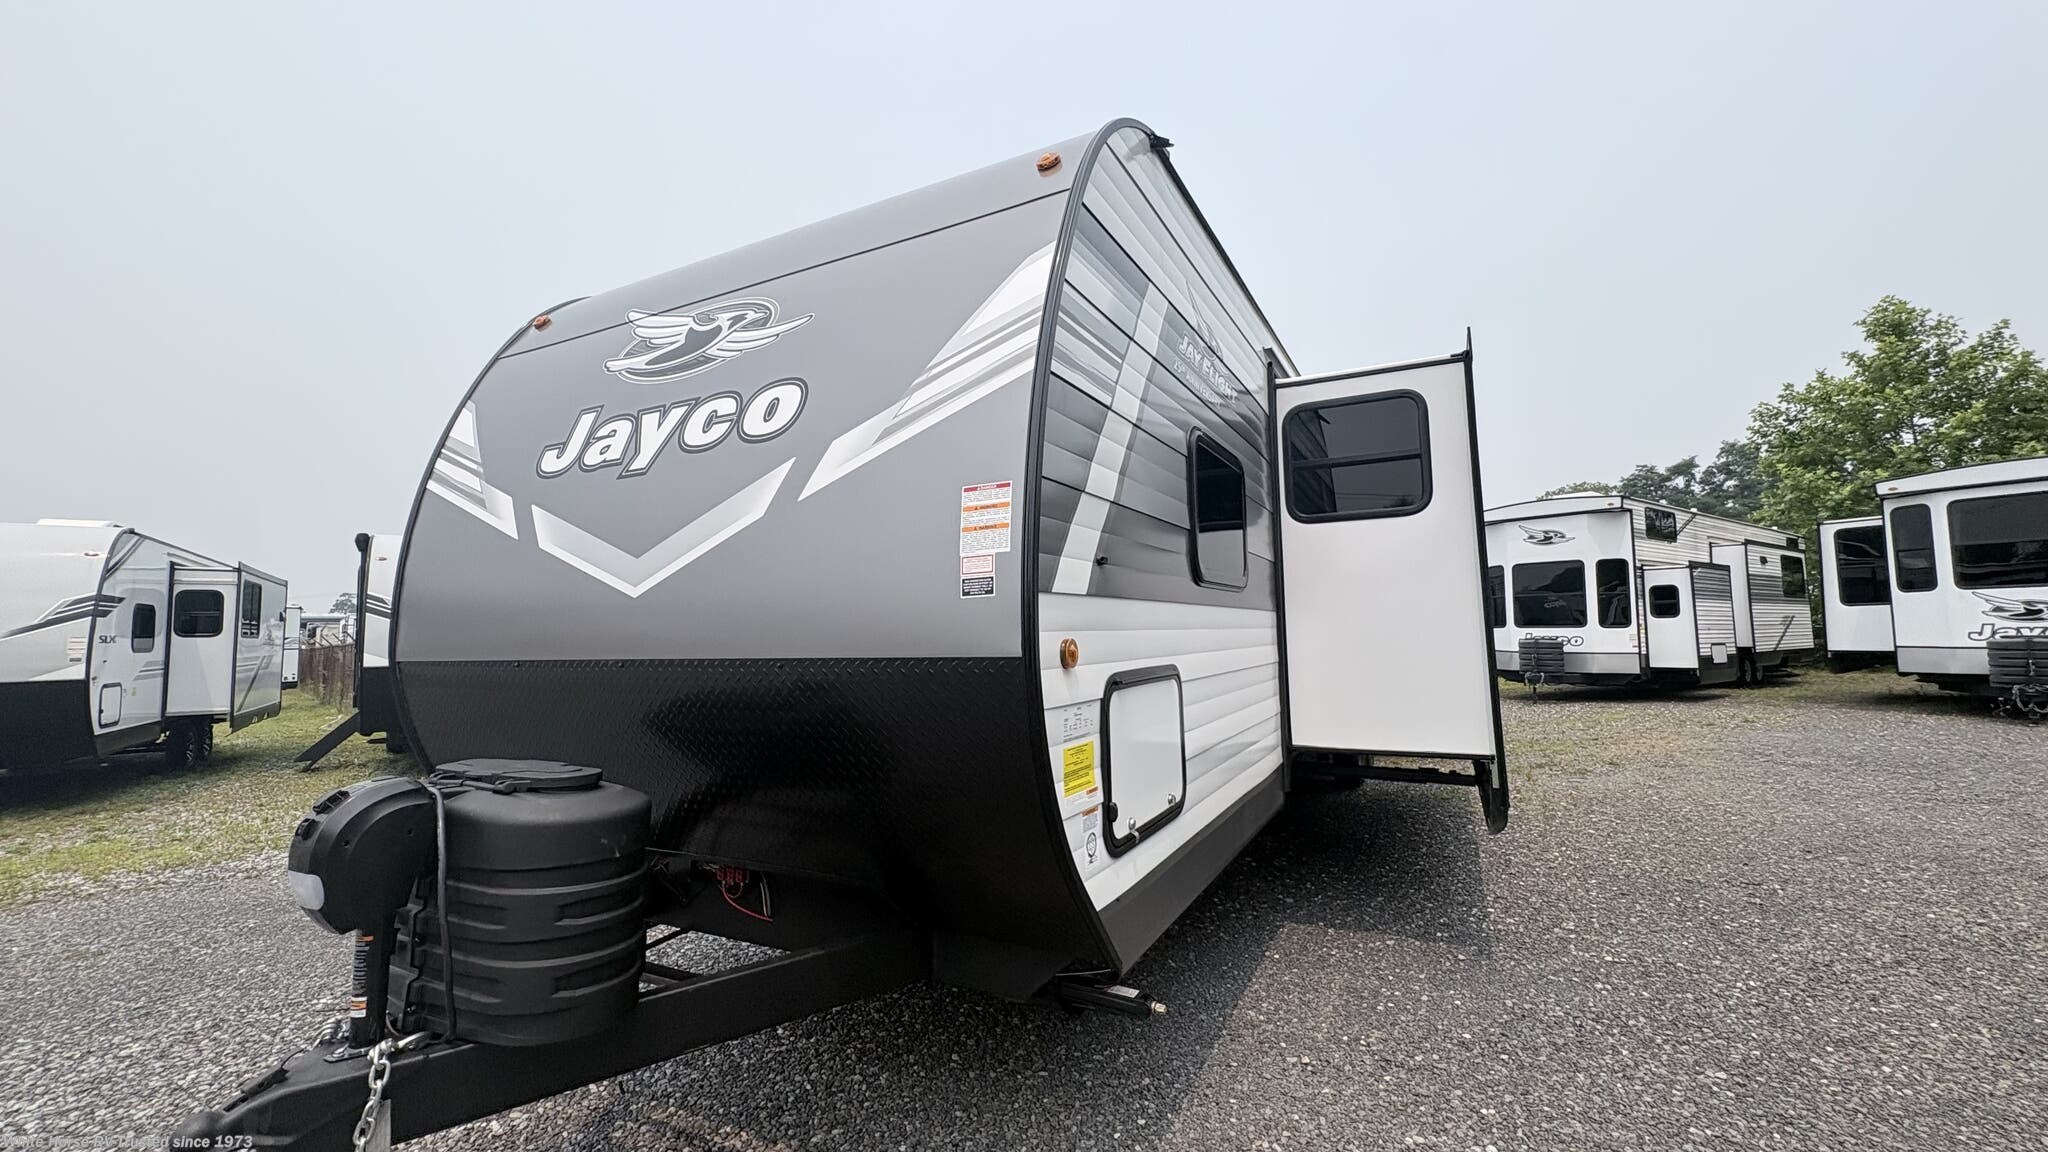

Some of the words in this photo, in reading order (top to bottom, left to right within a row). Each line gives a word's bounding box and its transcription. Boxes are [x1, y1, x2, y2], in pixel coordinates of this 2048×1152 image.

[1178, 334, 1203, 369] JAY
[1202, 356, 1237, 404] FLIGHT
[536, 376, 809, 480] Jayco
[98, 634, 117, 644] SLX
